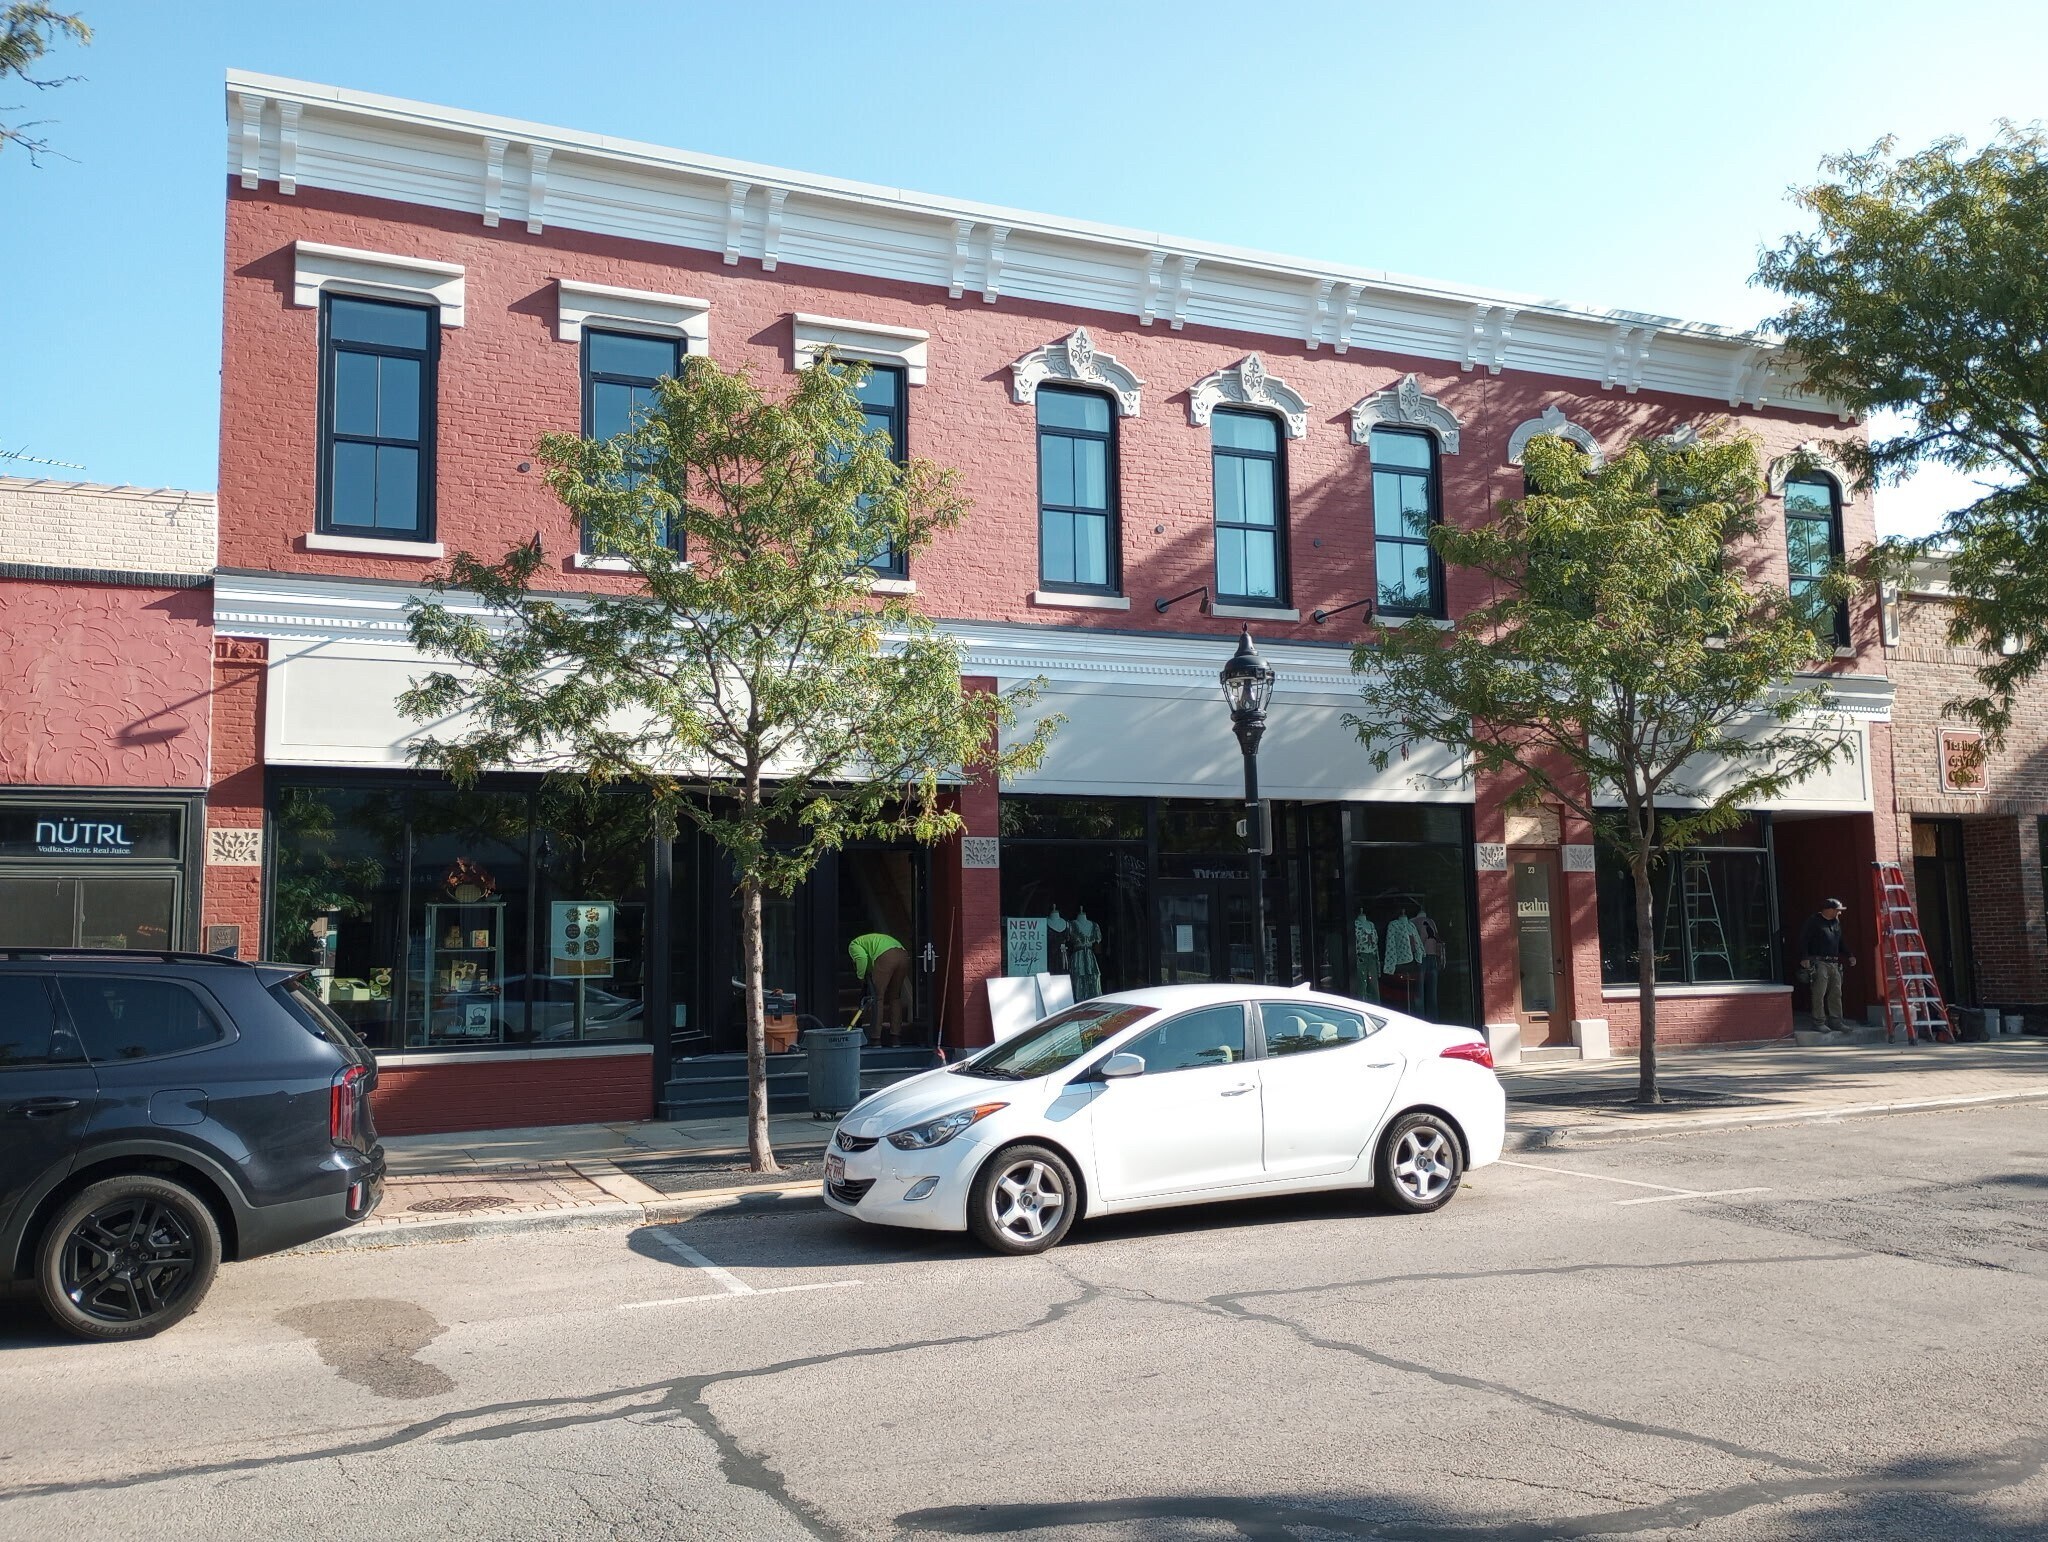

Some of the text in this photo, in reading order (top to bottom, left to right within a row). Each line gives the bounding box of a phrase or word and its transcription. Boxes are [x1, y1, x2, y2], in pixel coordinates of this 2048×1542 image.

[64, 846, 91, 854] Seltzer.
[1527, 866, 1535, 874] 23
[1517, 897, 1549, 912] realm
[1010, 920, 1038, 930] NEW
[1011, 931, 1045, 940] ARRI-
